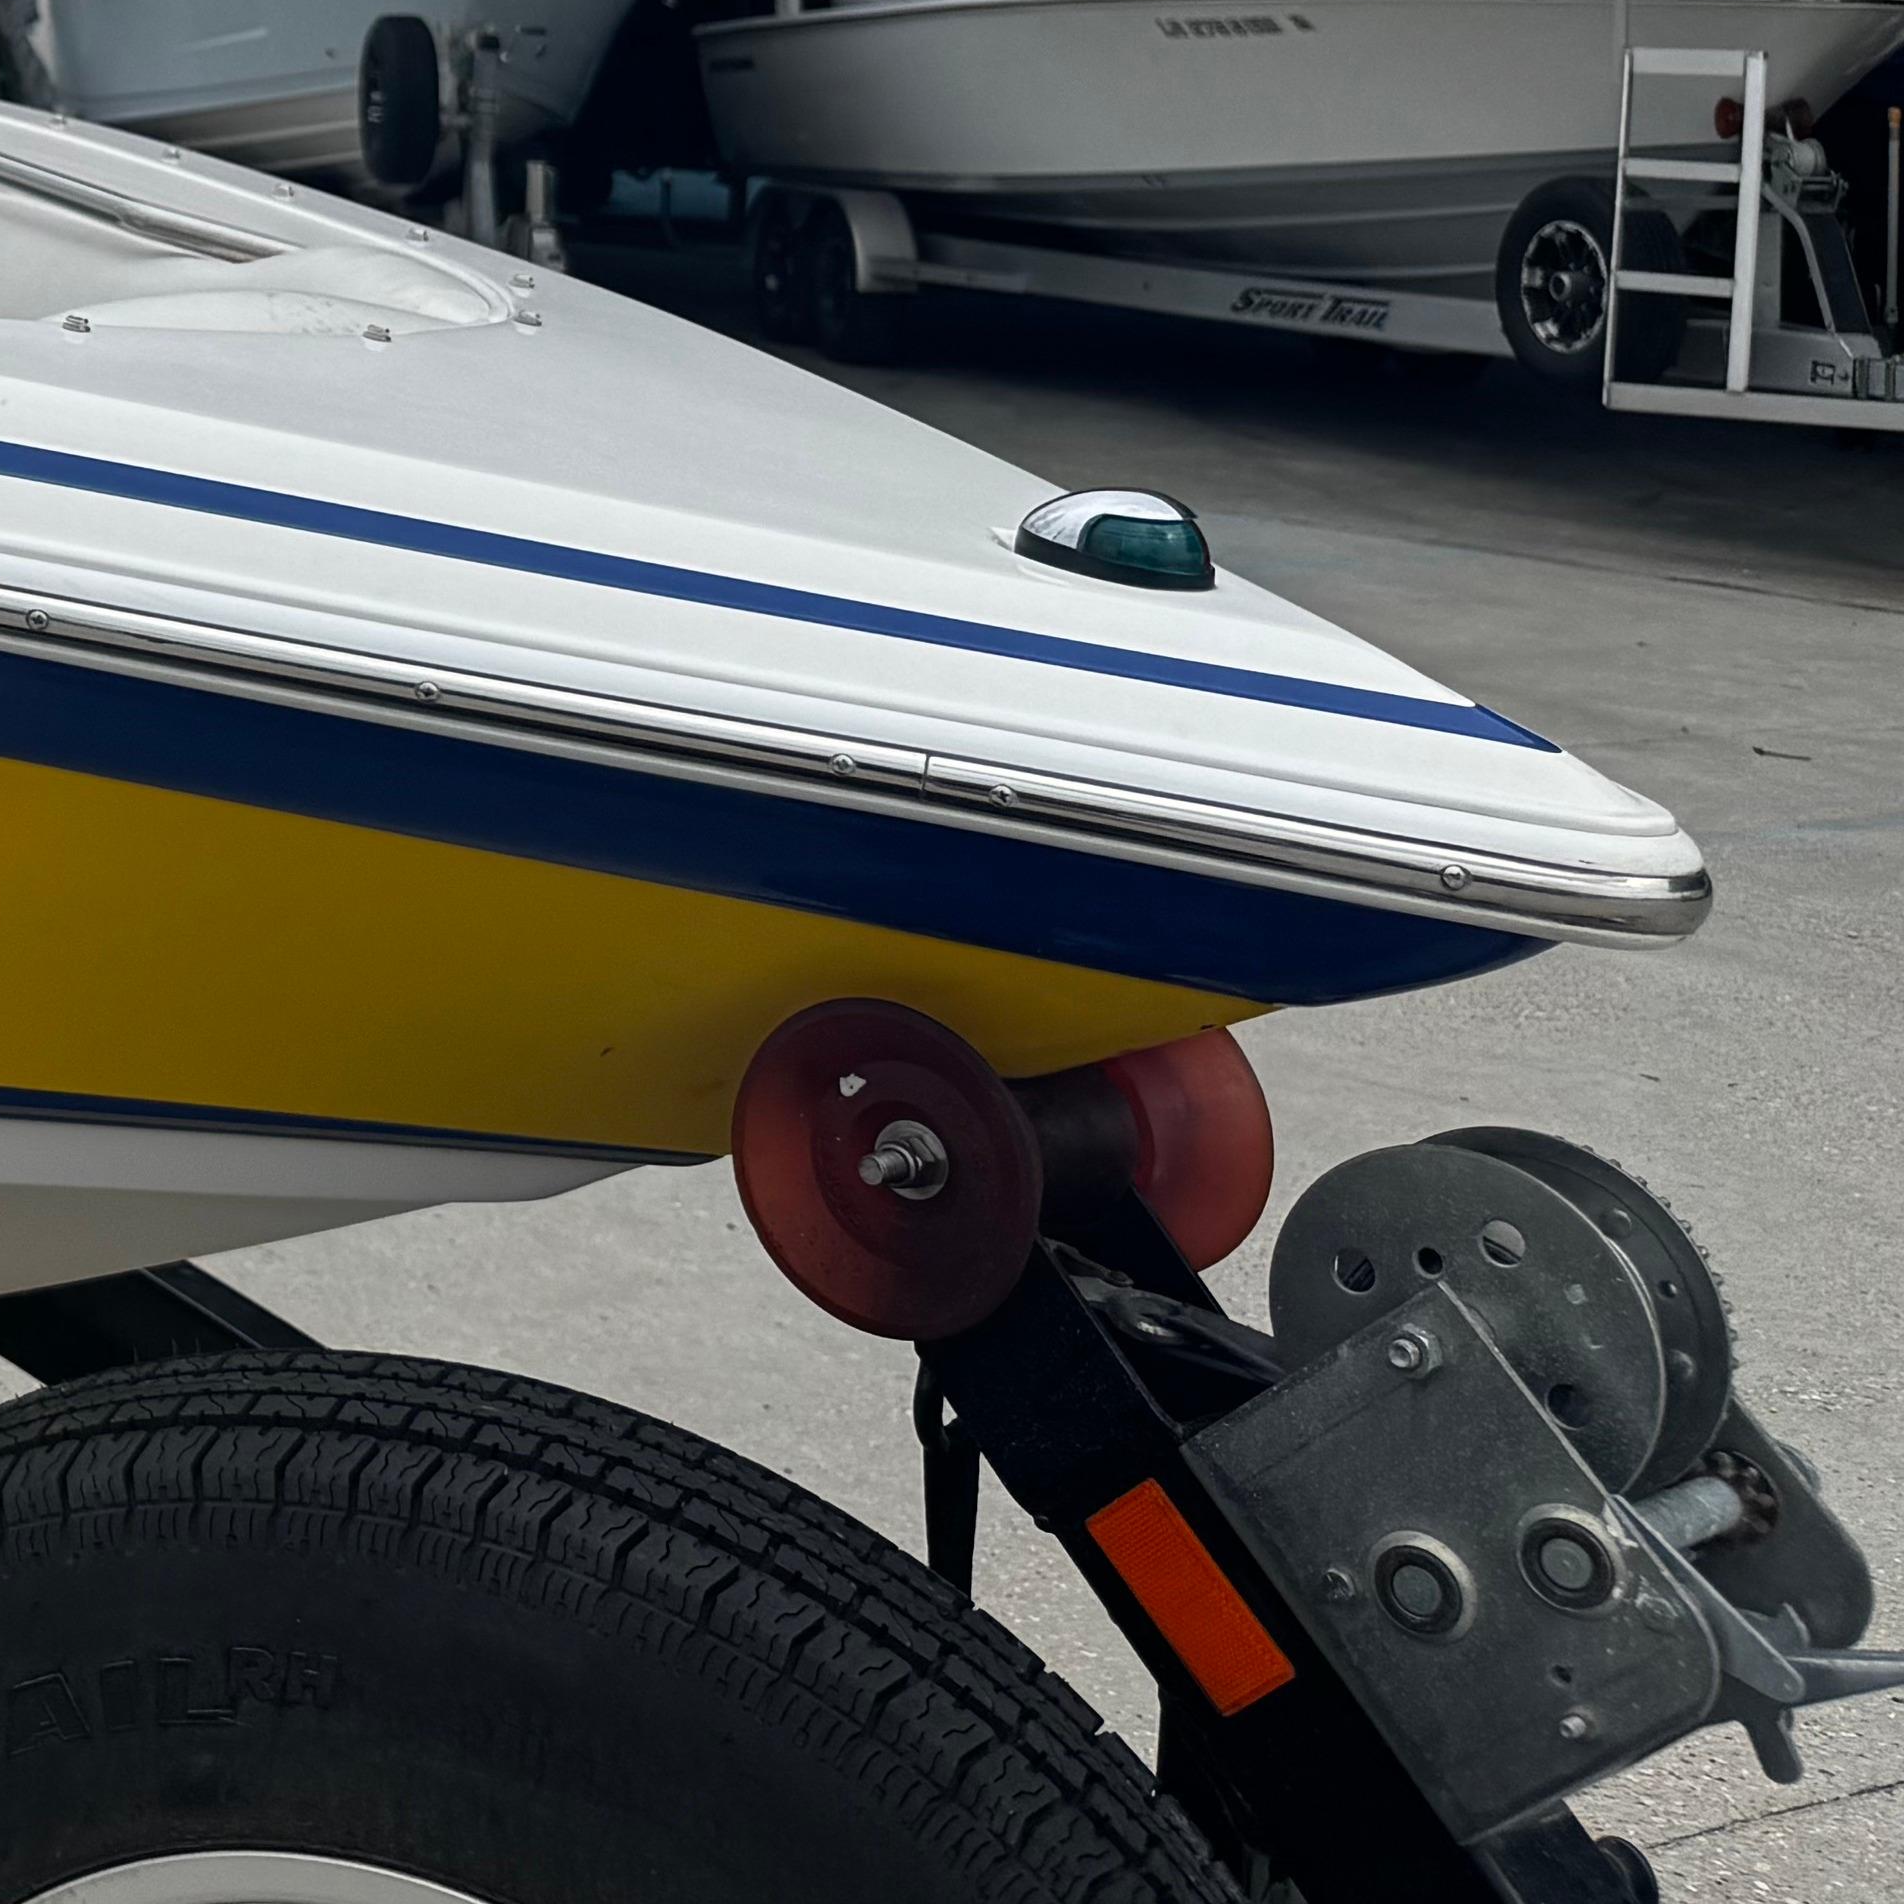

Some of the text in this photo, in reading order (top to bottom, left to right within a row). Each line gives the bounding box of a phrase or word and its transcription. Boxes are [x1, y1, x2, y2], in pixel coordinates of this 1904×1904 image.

[1230, 286, 1392, 331] SPORT TRAIL
[232, 1643, 345, 1709] RH
